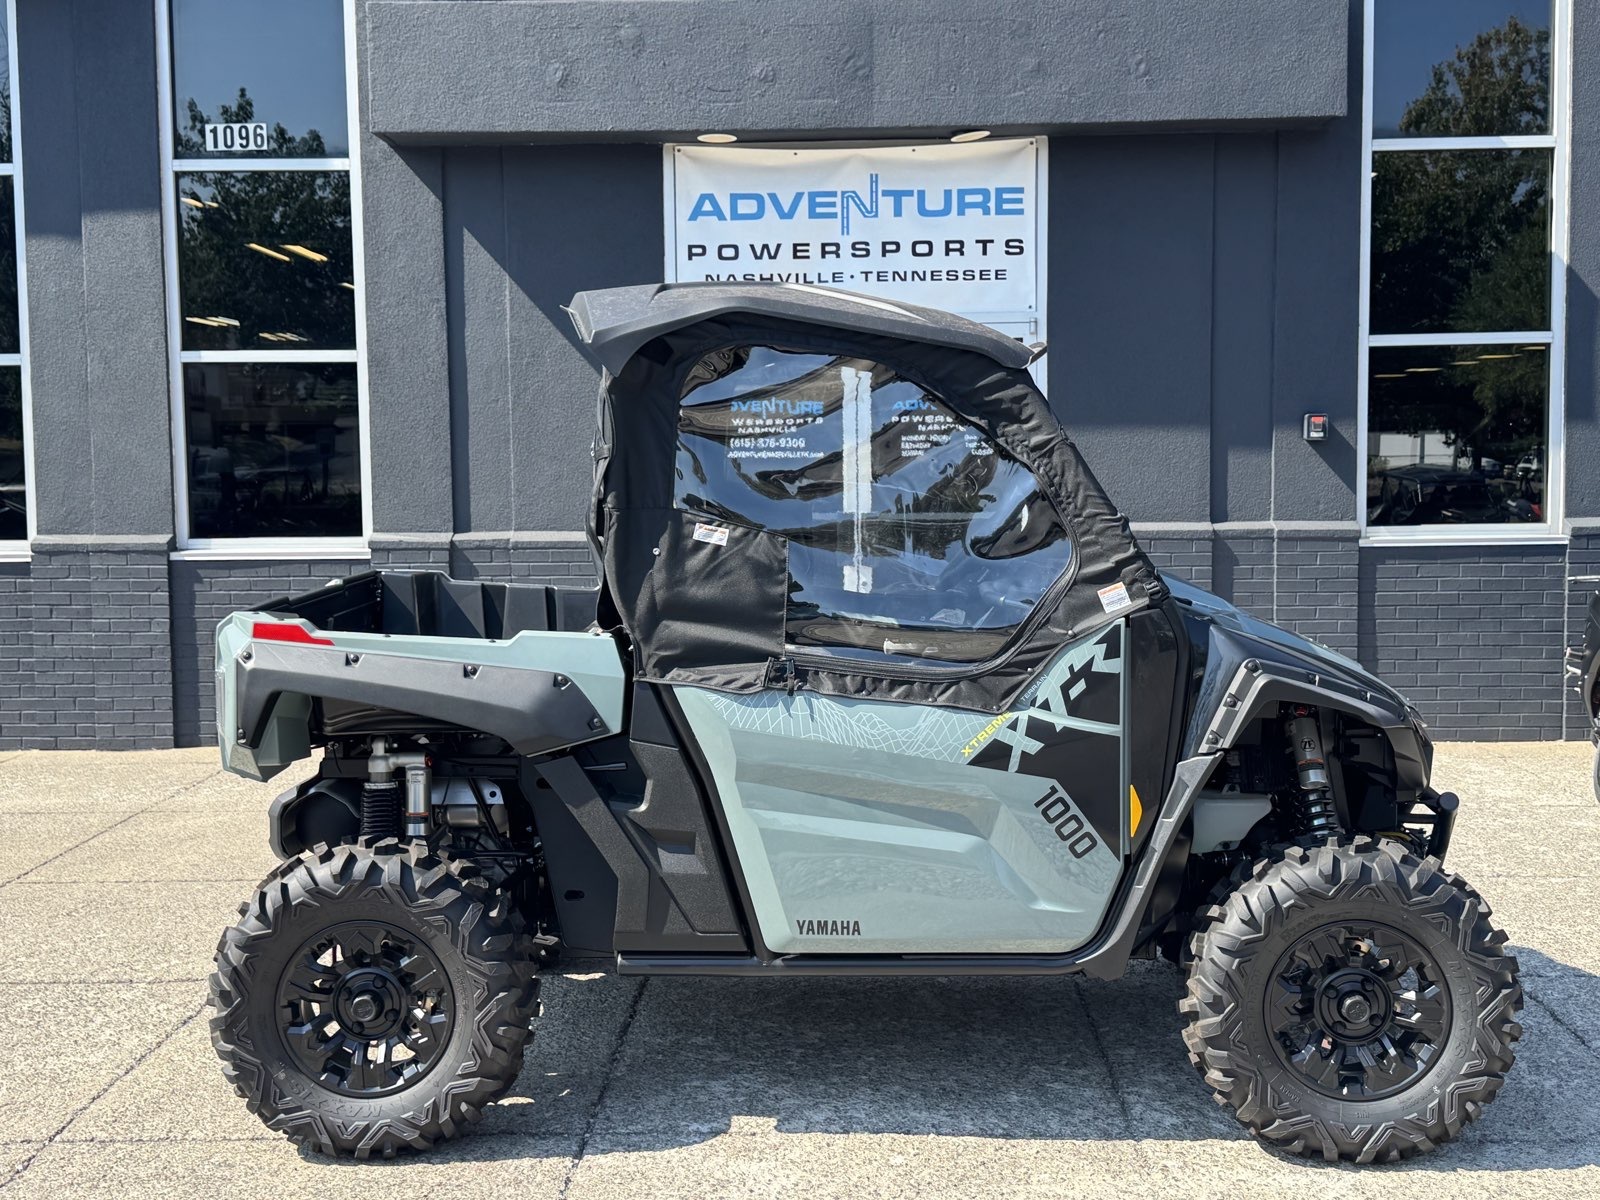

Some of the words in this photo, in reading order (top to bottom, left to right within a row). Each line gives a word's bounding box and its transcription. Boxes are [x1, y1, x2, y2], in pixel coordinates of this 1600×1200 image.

[209, 124, 266, 150] 1096
[687, 173, 1025, 236] ADVENTURE
[687, 238, 1025, 262] POWERSPORTS
[860, 269, 1008, 283] TENNESSEE
[1019, 673, 1049, 703] TERRAIN
[1033, 784, 1098, 859] 1000
[795, 919, 862, 936] YAMAHA
